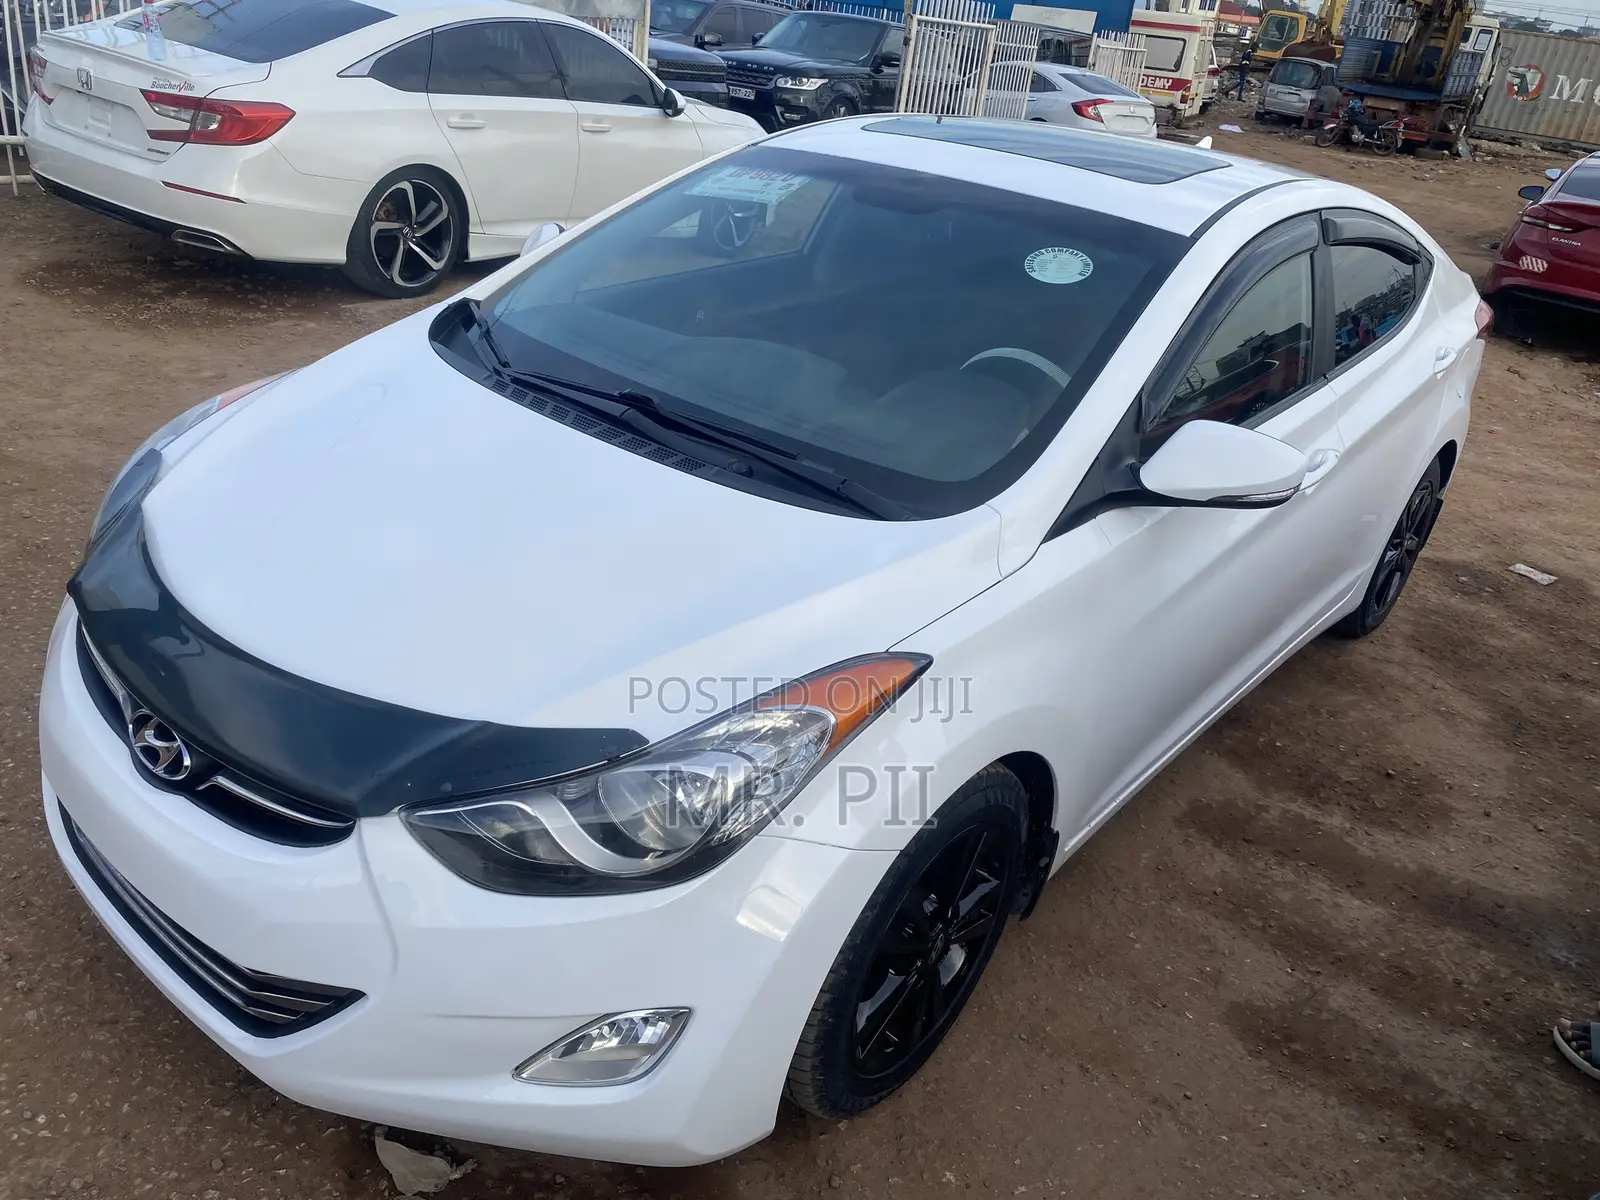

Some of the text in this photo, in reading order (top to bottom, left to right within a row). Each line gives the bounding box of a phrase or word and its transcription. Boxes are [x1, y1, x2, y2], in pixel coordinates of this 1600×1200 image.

[1552, 236, 1581, 246] ELANTRA
[1045, 248, 1085, 259] COMPANY
[1079, 259, 1091, 276] LIMITED
